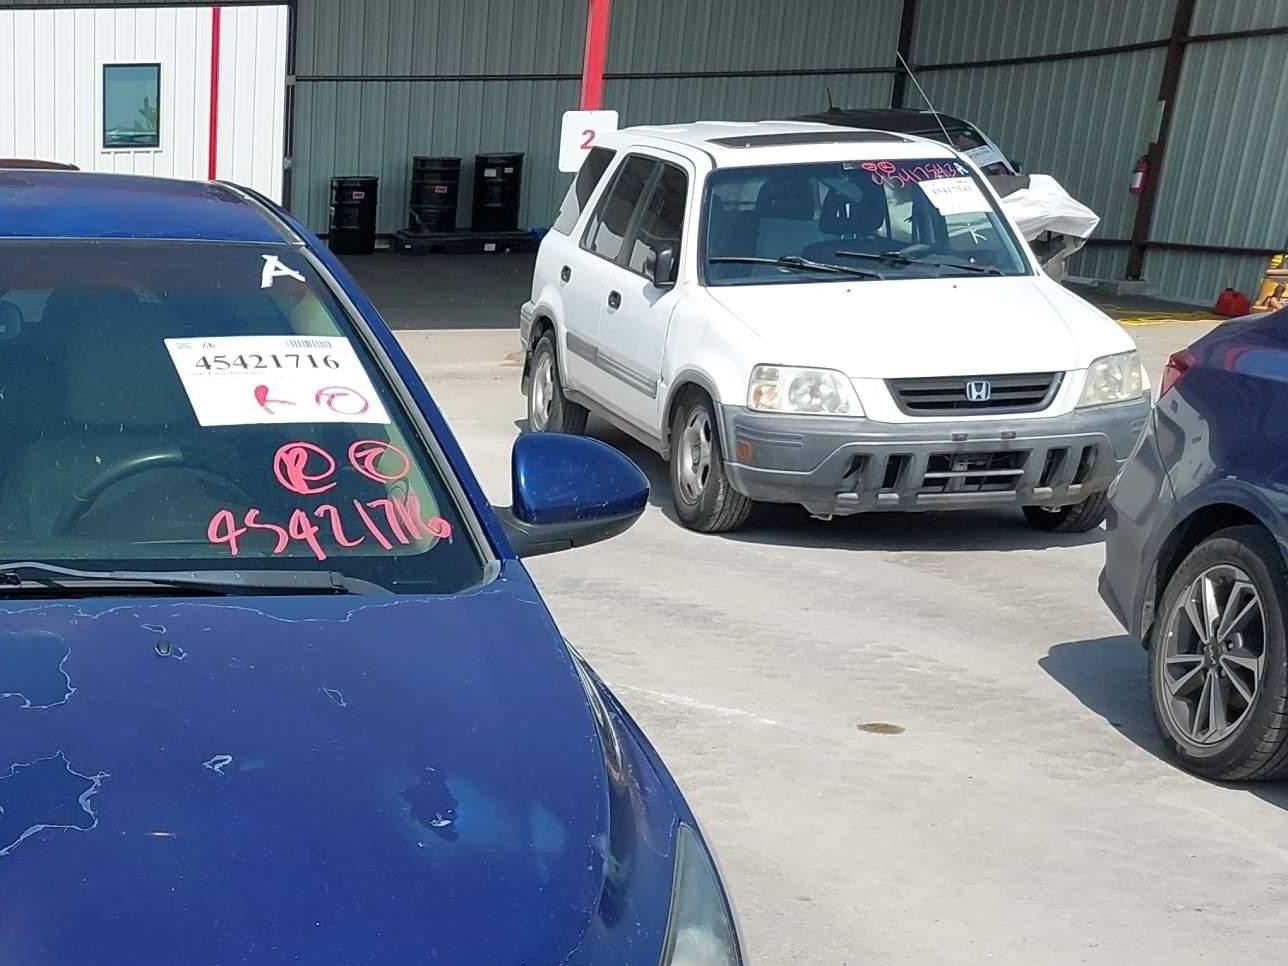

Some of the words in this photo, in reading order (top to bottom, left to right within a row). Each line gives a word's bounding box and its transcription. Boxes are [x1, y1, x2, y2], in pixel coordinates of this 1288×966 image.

[580, 129, 596, 149] 2
[261, 254, 306, 288] A
[195, 353, 340, 370] 45421716
[207, 489, 454, 561] 45421716
